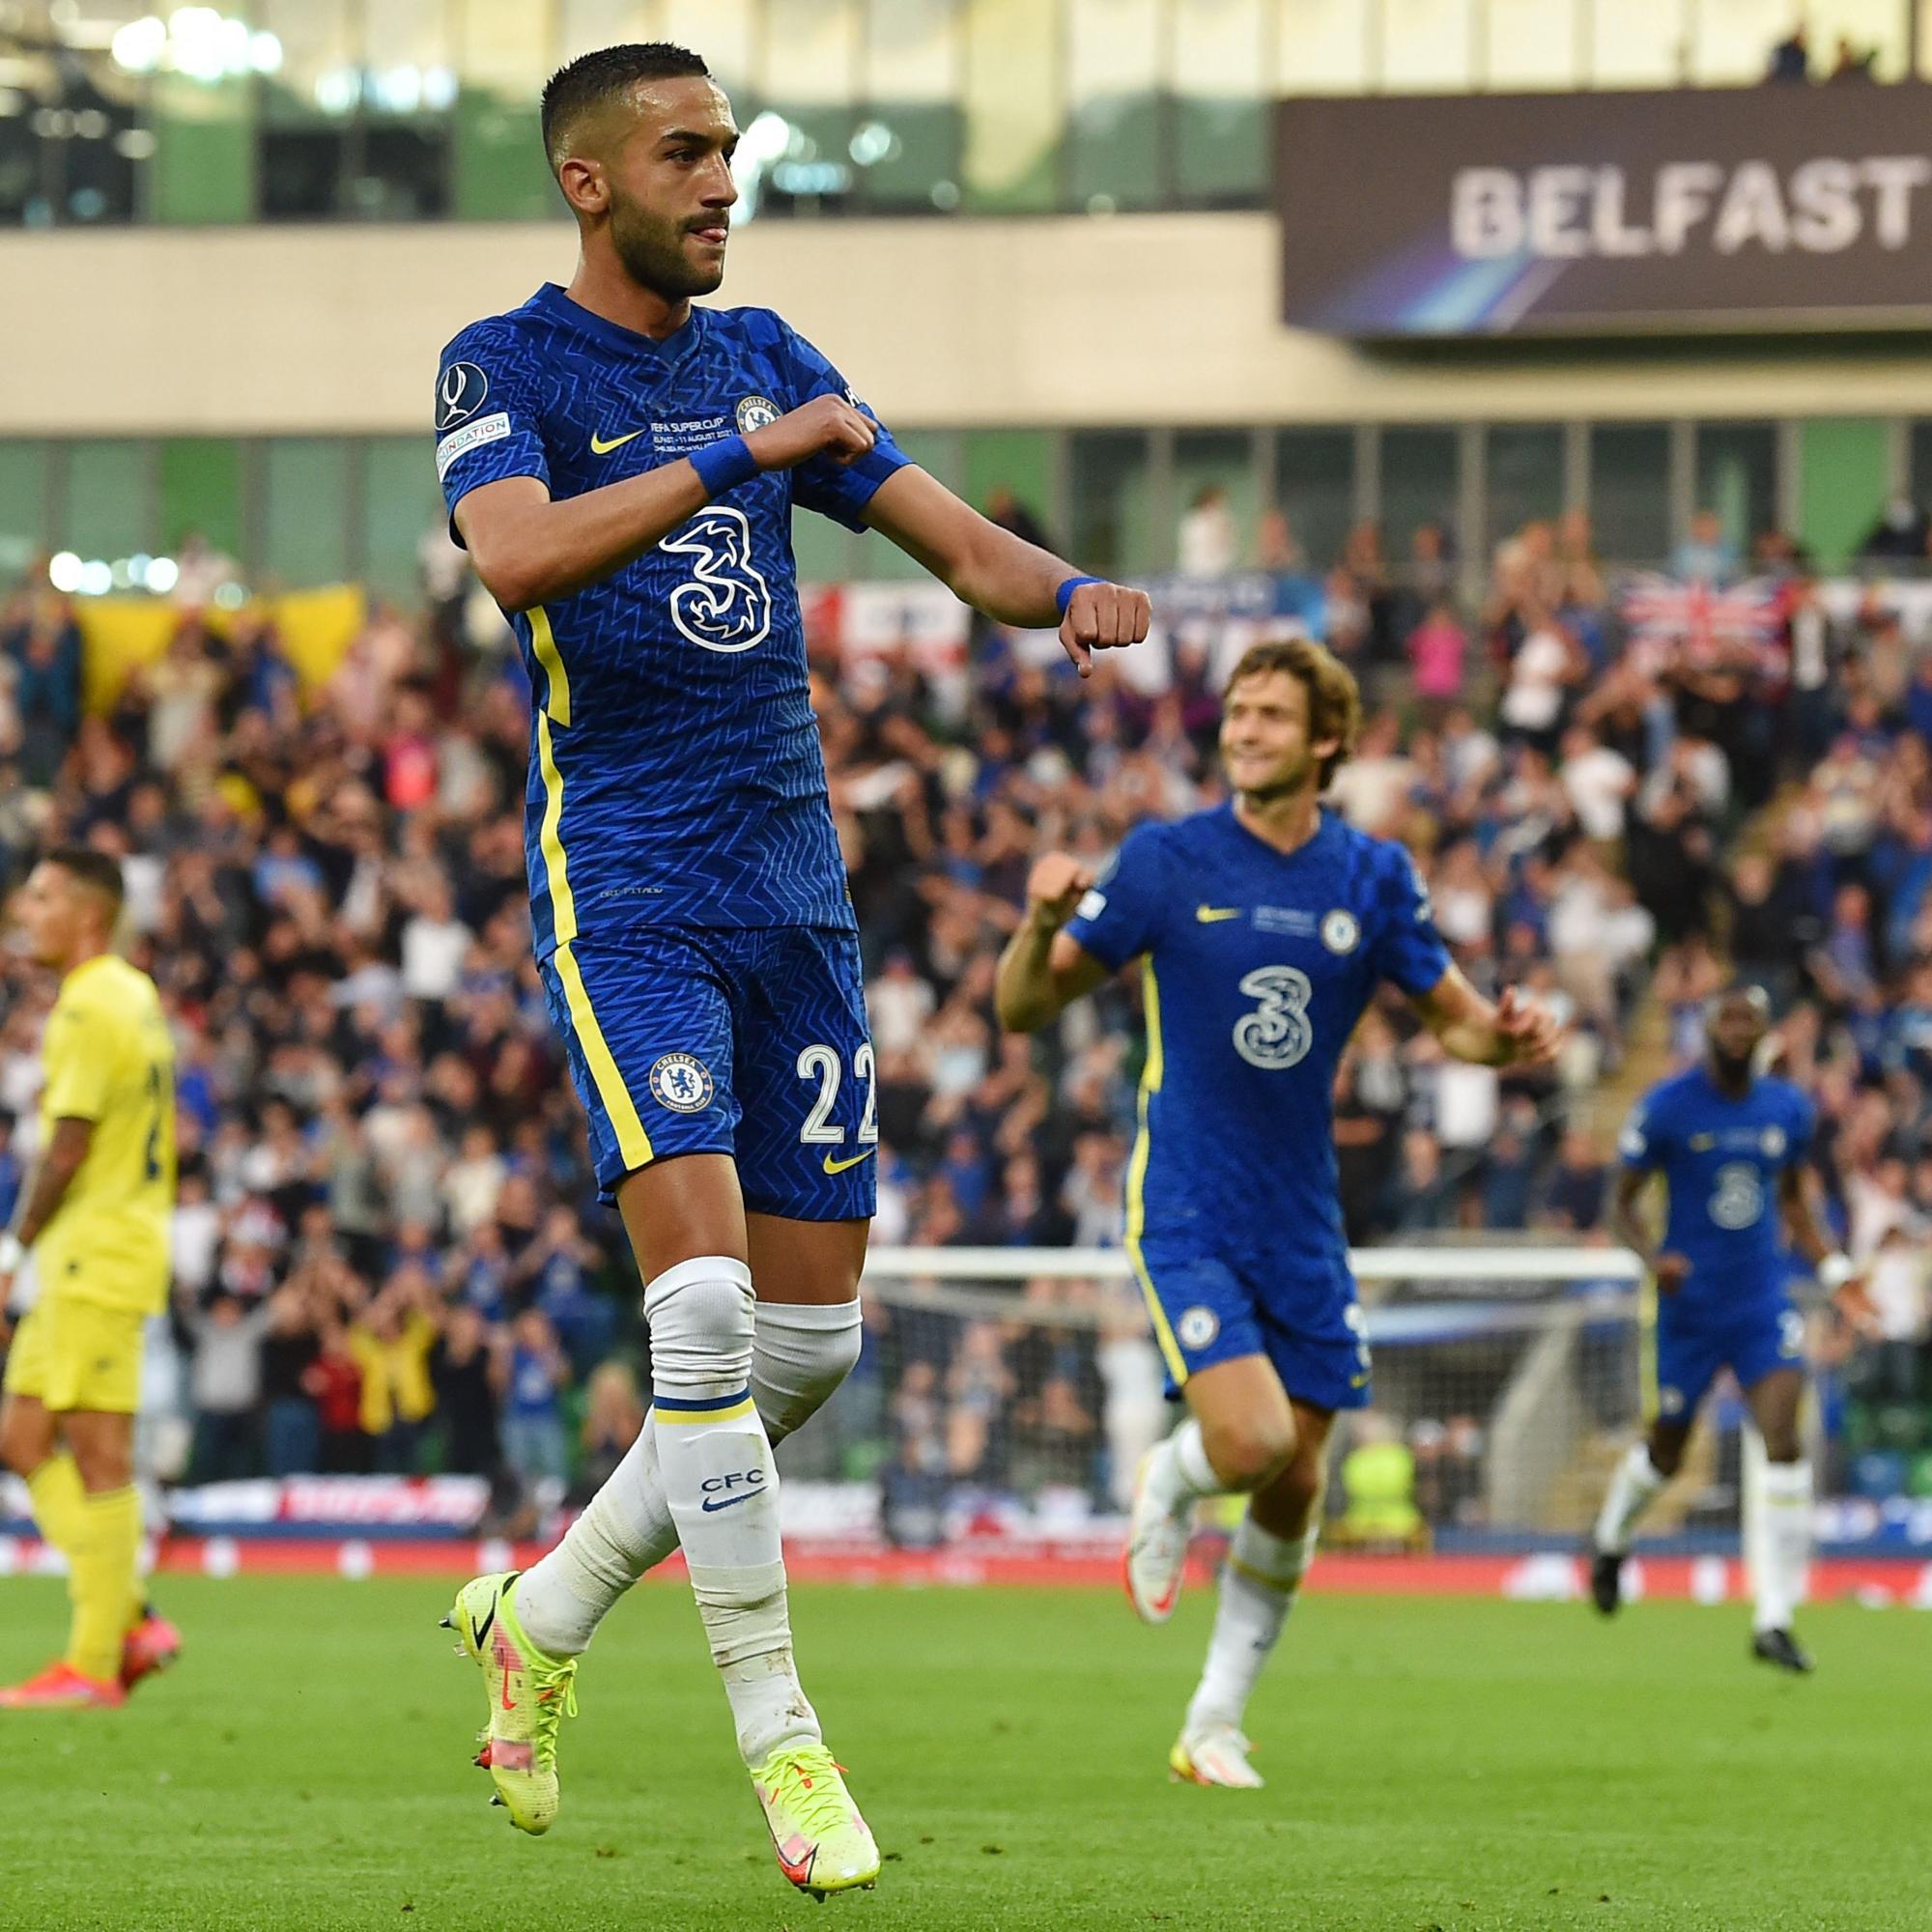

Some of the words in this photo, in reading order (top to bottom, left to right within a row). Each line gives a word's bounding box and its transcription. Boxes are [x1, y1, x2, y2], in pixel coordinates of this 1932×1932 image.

[1451, 156, 1931, 259] BELFAST
[741, 398, 773, 412] CHELSEA
[670, 420, 701, 433] SUPER
[699, 416, 724, 431] CUP
[1233, 964, 1314, 1070] 3
[656, 1055, 696, 1070] CHELSEA
[797, 1042, 879, 1145] 22
[701, 1468, 764, 1492] CFC
